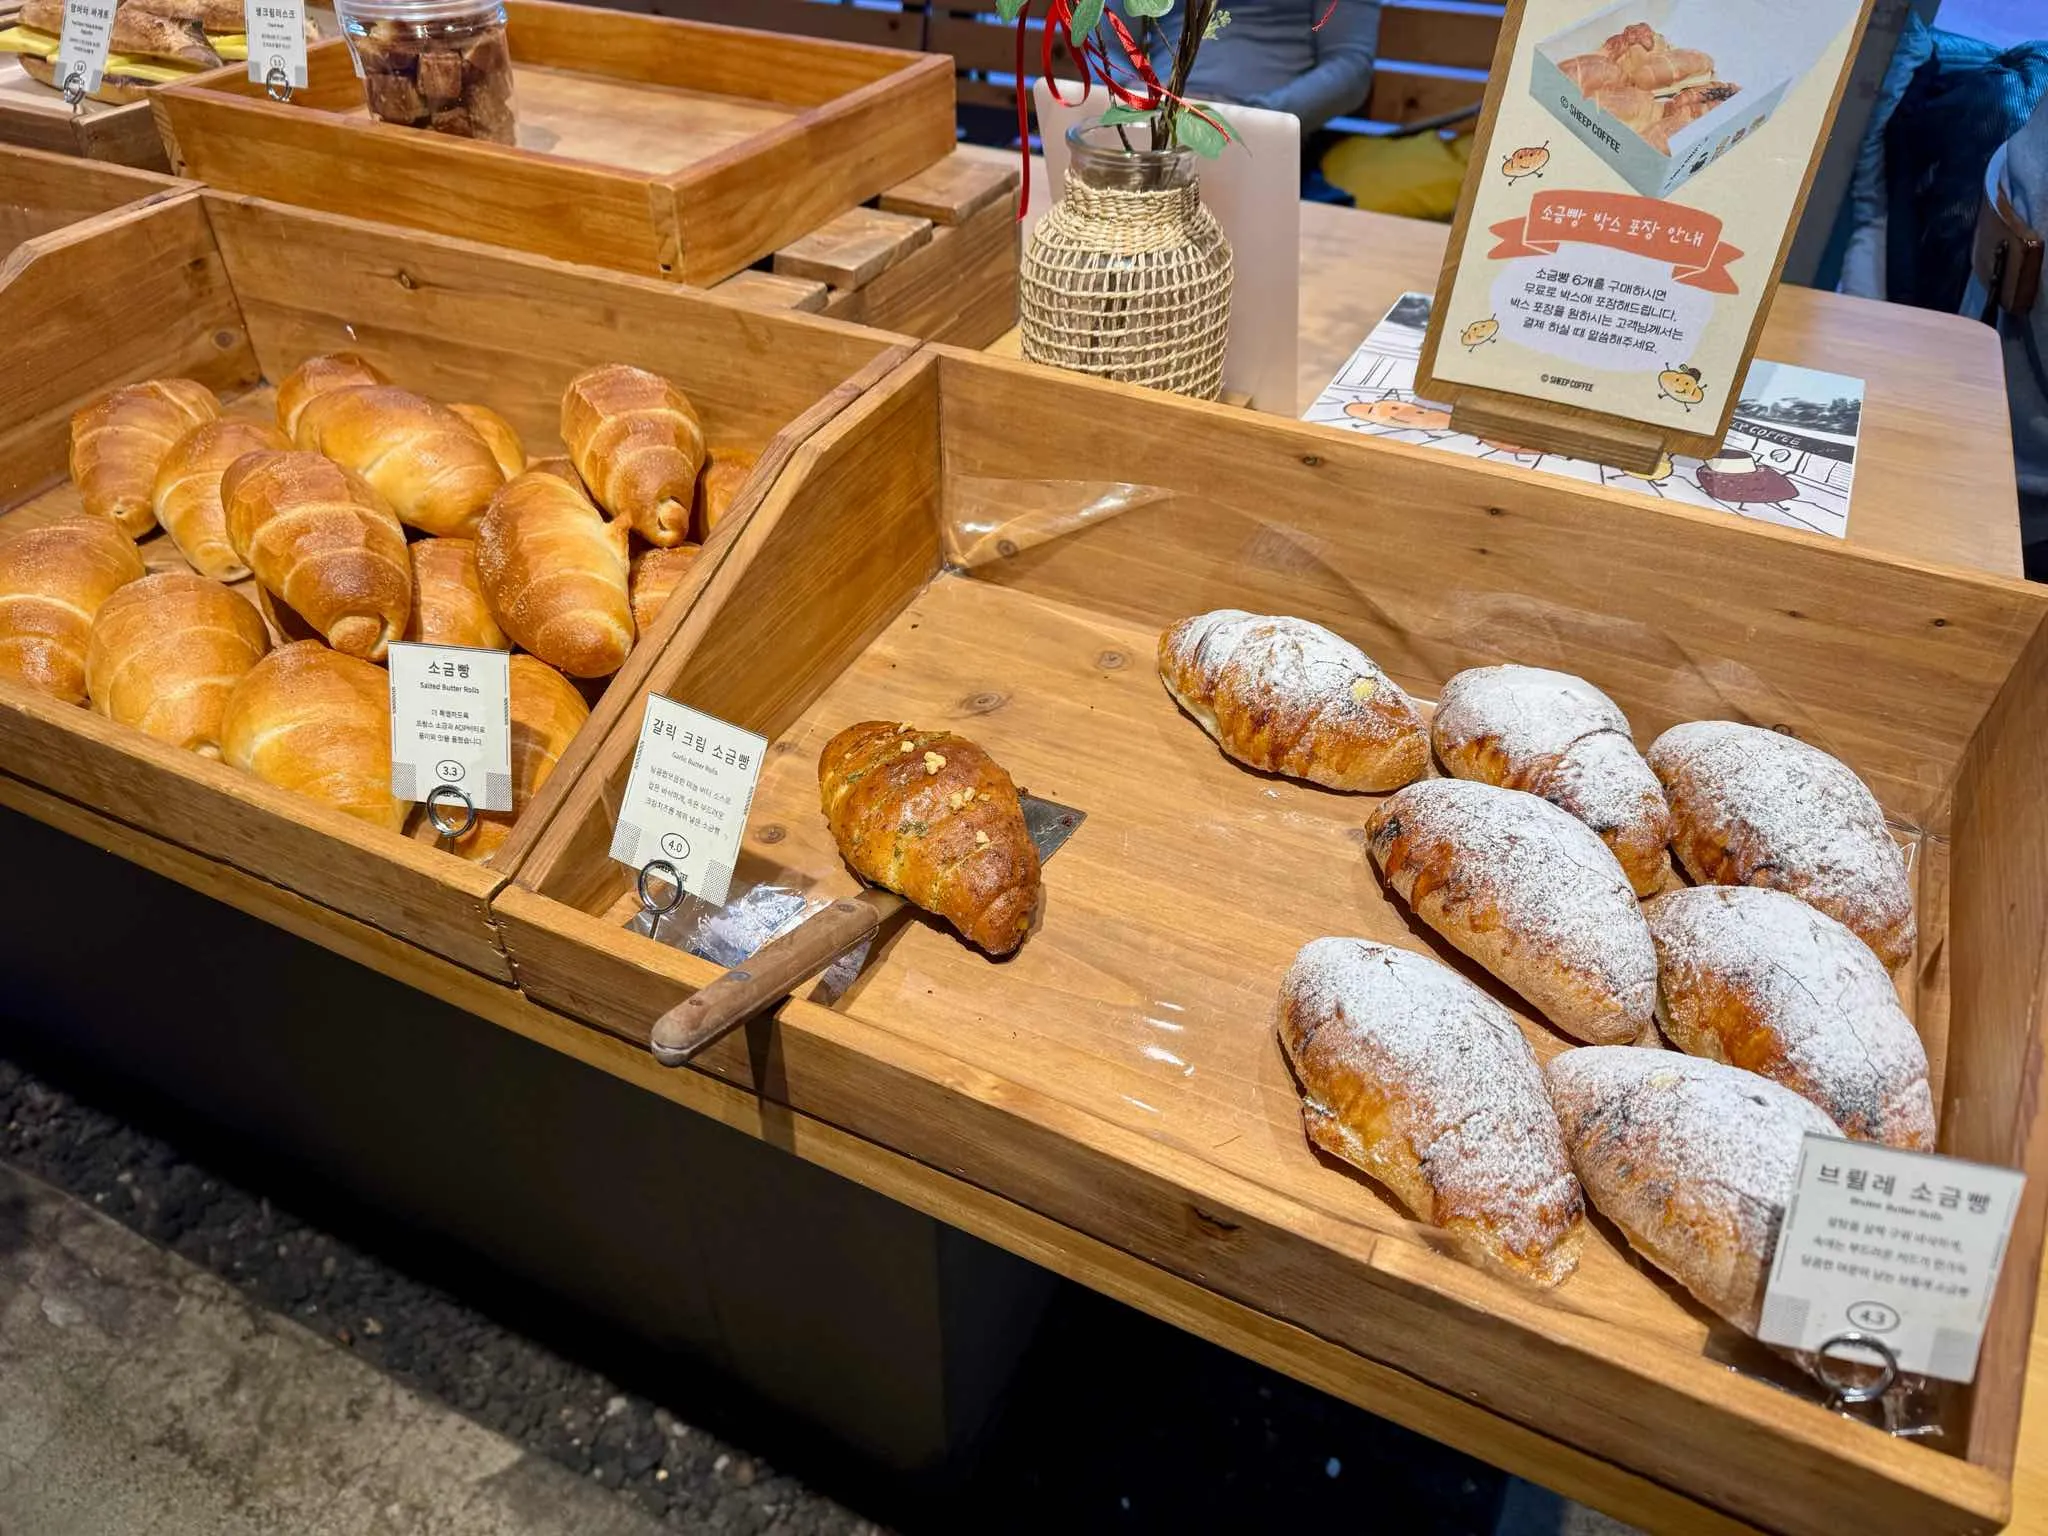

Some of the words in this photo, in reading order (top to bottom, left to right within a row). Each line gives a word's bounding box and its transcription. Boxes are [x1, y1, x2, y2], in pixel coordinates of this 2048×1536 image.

[1569, 103, 1592, 128] SHEEP
[1592, 123, 1621, 154] COFFEE
[1540, 205, 1587, 227] 소금빵
[1593, 212, 1621, 233] 박스
[1627, 219, 1661, 241] 포장
[1667, 226, 1704, 248] 안내
[1524, 282, 1557, 298] 무료로
[1560, 289, 1593, 304] 박스에
[1595, 296, 1677, 322] 포장해드립니다.
[1536, 268, 1570, 284] 소금빵
[1572, 274, 1604, 290] 6개를
[1608, 280, 1667, 301] 구매하시면
[1510, 297, 1530, 310] 박스
[1533, 301, 1565, 317] 포장을
[1568, 308, 1613, 327] 원하시는
[1615, 317, 1684, 341] 고객님께서는
[1523, 317, 1545, 329] 결제
[1548, 321, 1570, 336] 하실
[1572, 327, 1586, 338] 때
[1588, 329, 1657, 354] 말씀해주세요.
[1550, 375, 1570, 386] SHEEP
[1570, 379, 1594, 392] COFFEE
[428, 661, 470, 678] 소금빵
[420, 682, 440, 690] Salted
[442, 684, 462, 692] Butter
[463, 686, 480, 694] Rolls
[652, 718, 677, 741] 갈릭
[681, 731, 707, 753] 크림
[711, 744, 750, 771] 소금빵
[443, 766, 458, 776] 3.3
[668, 840, 683, 853] 4.0
[1817, 1164, 1896, 1197] 브륄레
[1910, 1182, 1991, 1215] 소금빵
[1861, 1309, 1886, 1326] 4.3
